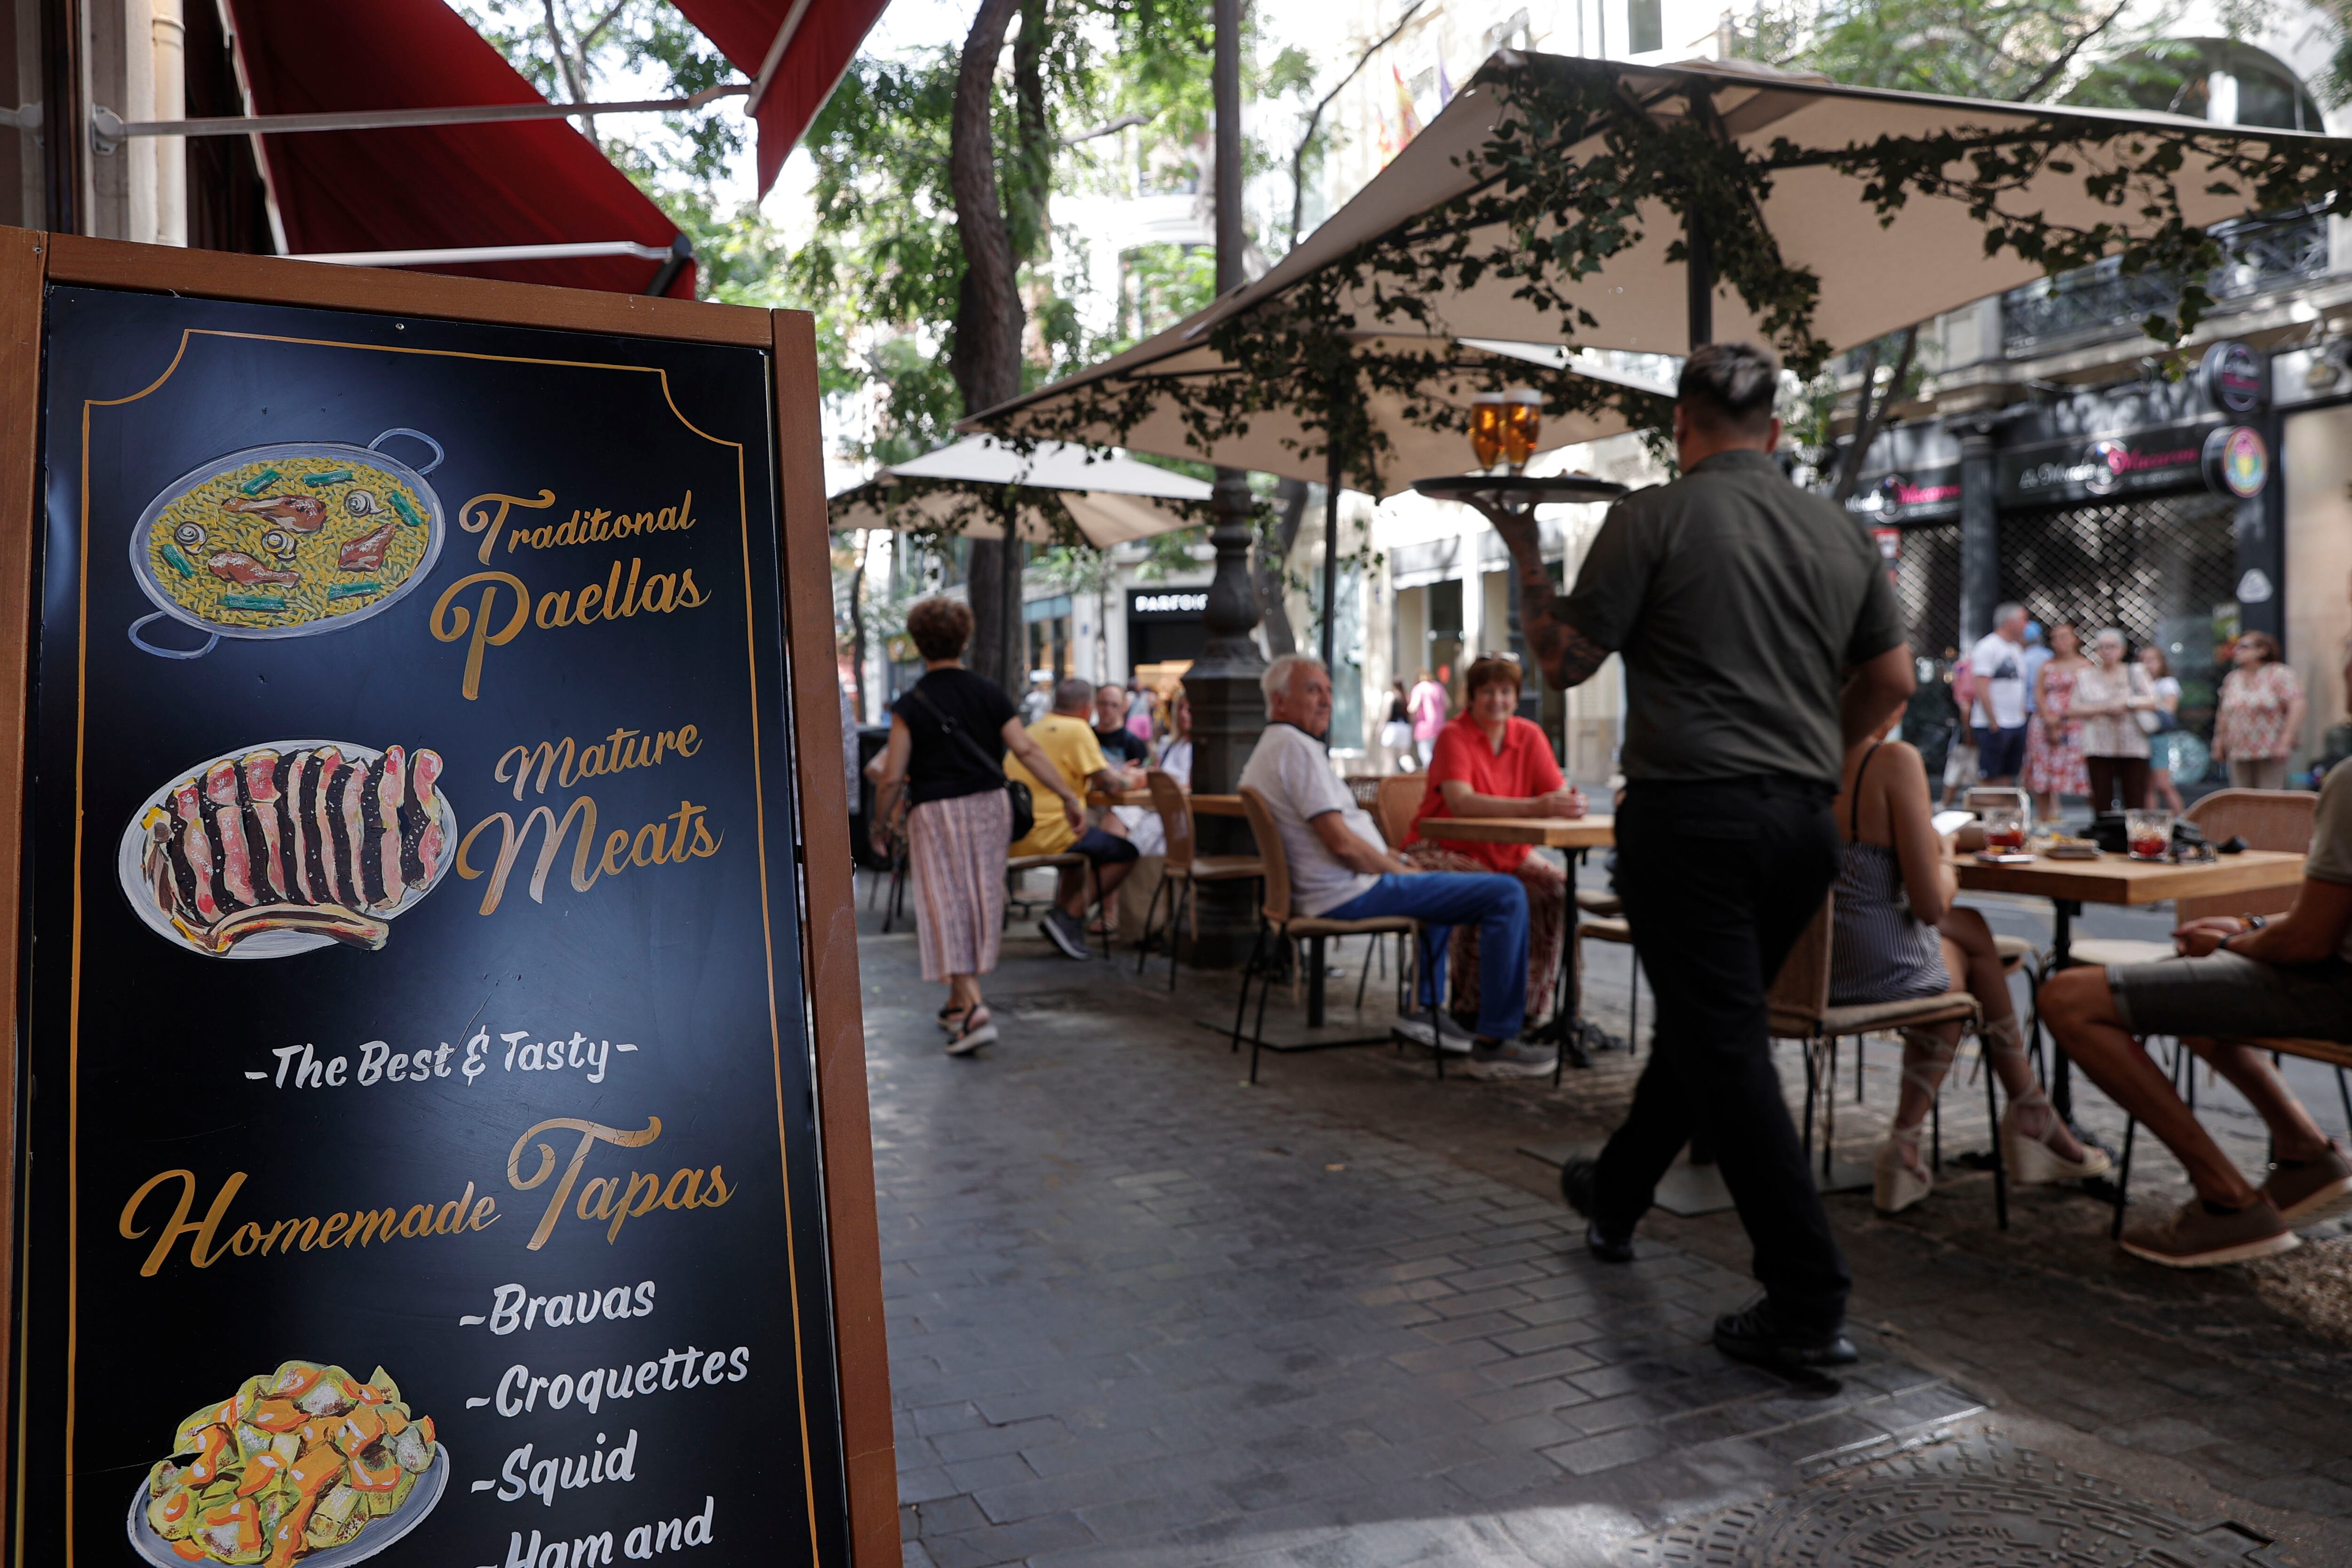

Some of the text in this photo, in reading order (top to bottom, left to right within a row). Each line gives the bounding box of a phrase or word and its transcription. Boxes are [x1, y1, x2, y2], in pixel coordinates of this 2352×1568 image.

[459, 489, 696, 565] Traditional
[429, 557, 712, 701] Paellas
[494, 724, 703, 801] Mature
[456, 796, 725, 916] Meats
[357, 1040, 456, 1087] Best
[463, 1025, 489, 1087] &
[118, 1116, 737, 1278] Homemade Tapas
[624, 1496, 714, 1559] and
